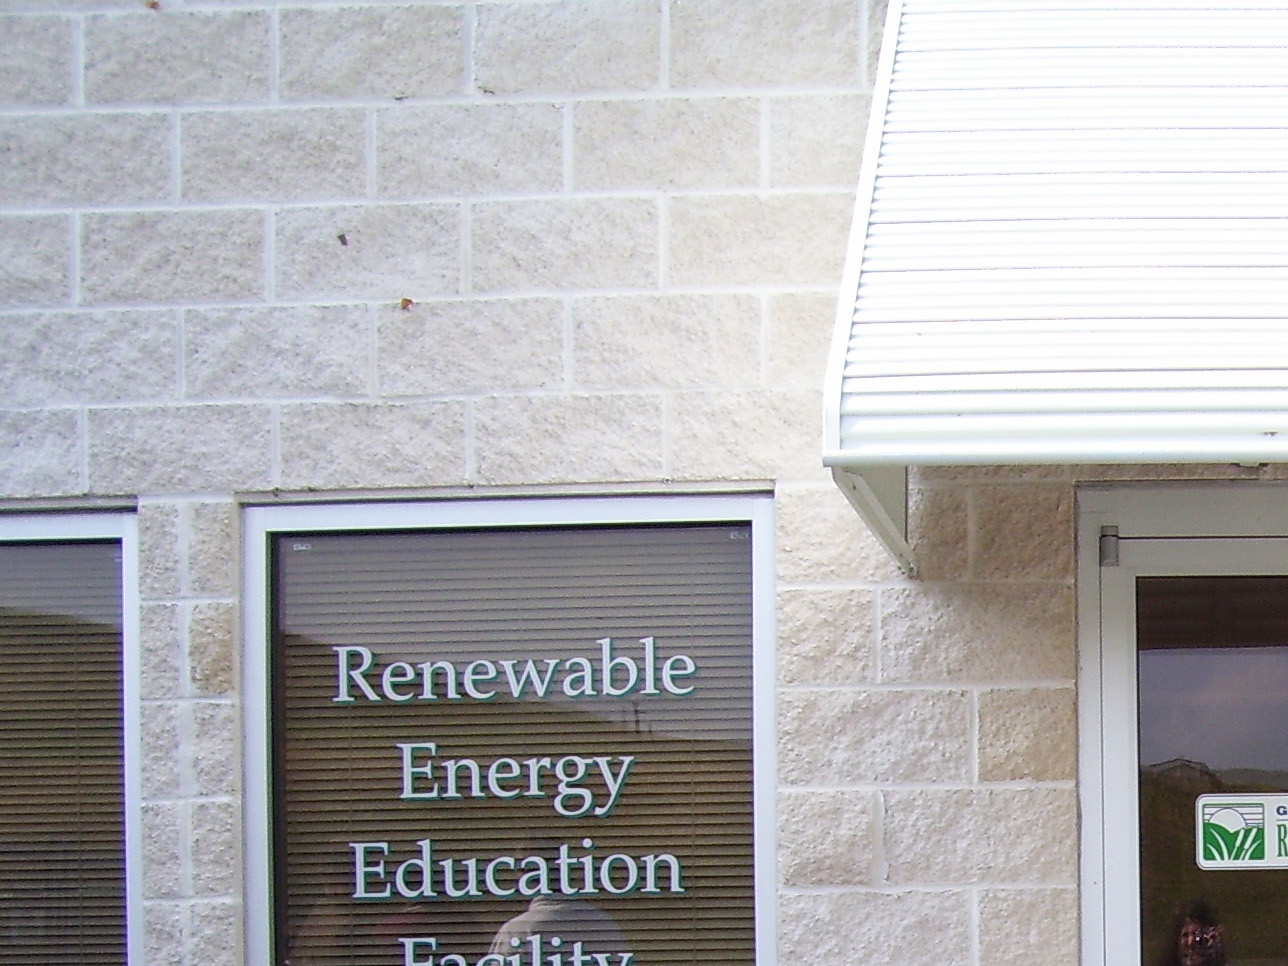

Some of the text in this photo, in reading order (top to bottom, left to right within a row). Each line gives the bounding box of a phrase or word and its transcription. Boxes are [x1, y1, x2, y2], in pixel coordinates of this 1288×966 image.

[332, 636, 697, 703] Renewable
[396, 741, 636, 818] Energy
[349, 838, 686, 901] Education
